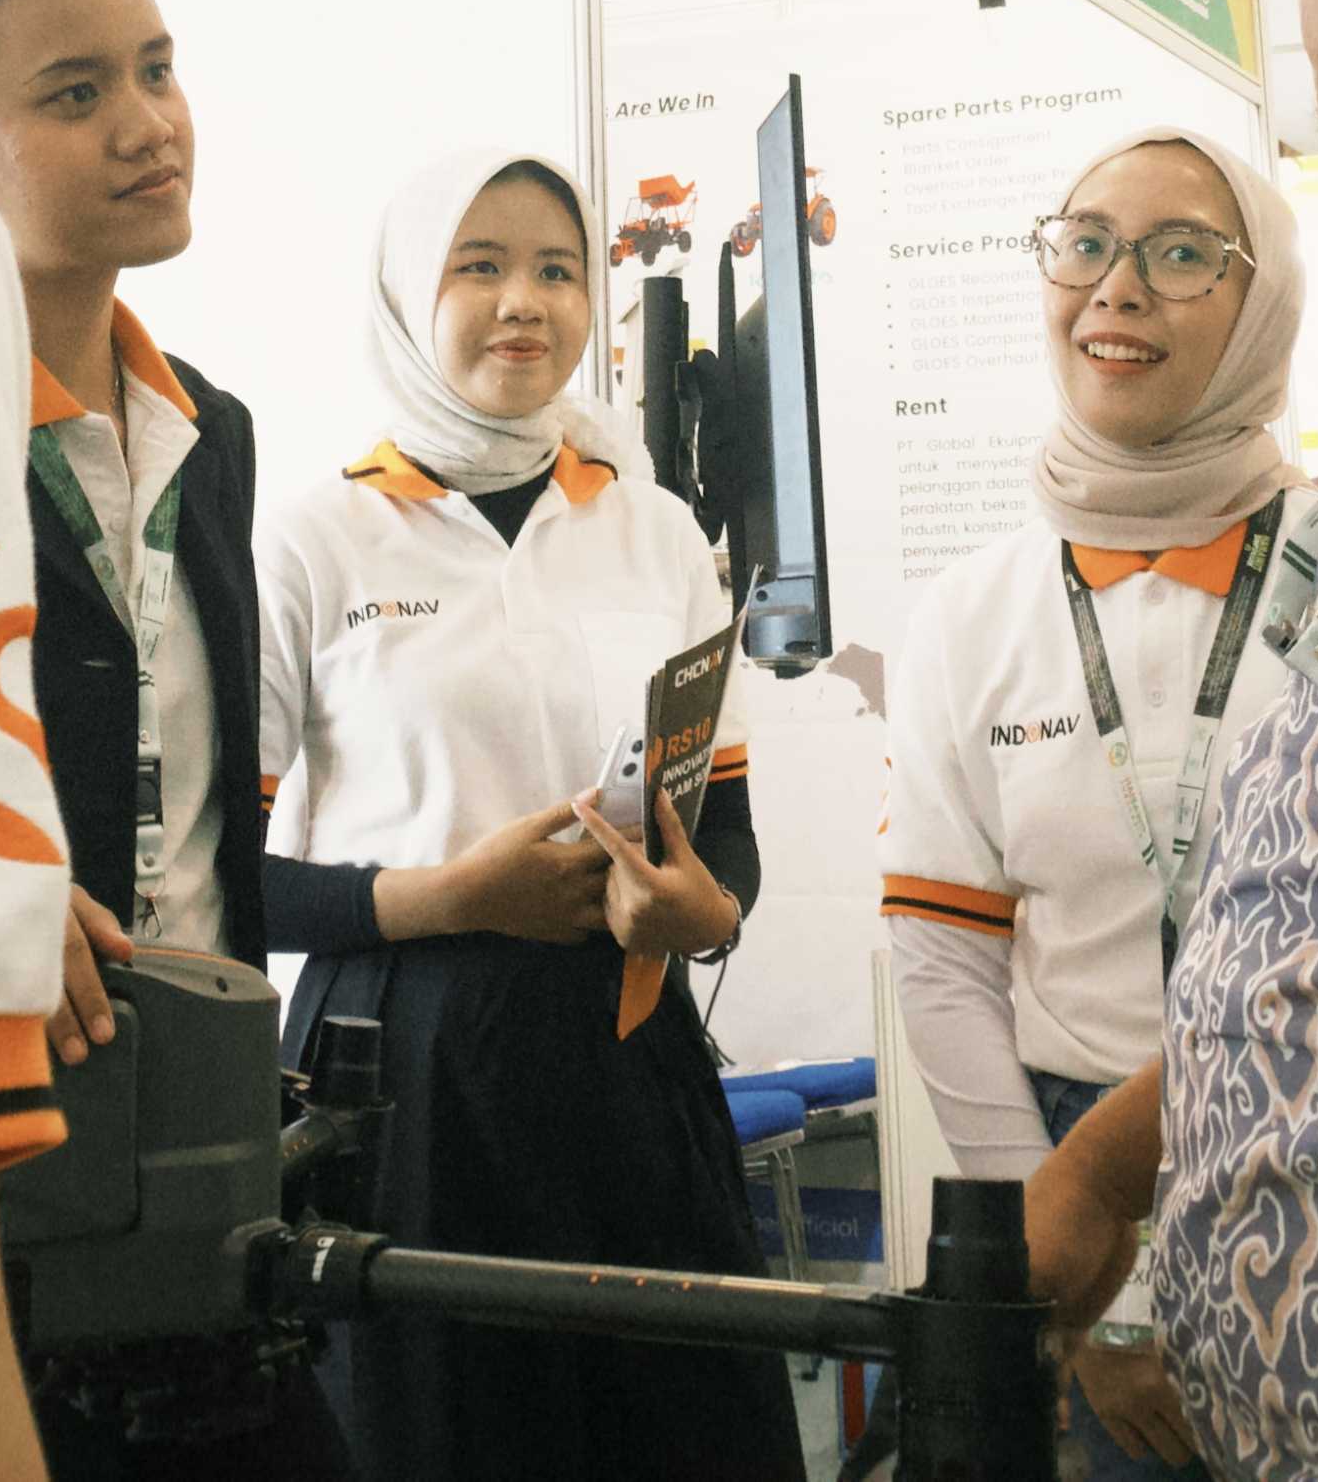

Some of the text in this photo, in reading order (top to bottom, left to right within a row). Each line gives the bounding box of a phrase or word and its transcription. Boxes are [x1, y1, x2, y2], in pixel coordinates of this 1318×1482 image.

[615, 92, 716, 118] Are We In
[883, 87, 1122, 129] Spare Parts Program
[889, 234, 1035, 259] Service Prog
[895, 398, 947, 416] Rent
[926, 434, 975, 451] Global
[899, 460, 940, 474] untuk
[899, 479, 981, 497] pelanggan
[900, 498, 1027, 517] peralatan bekas
[347, 599, 439, 629] INDONAV
